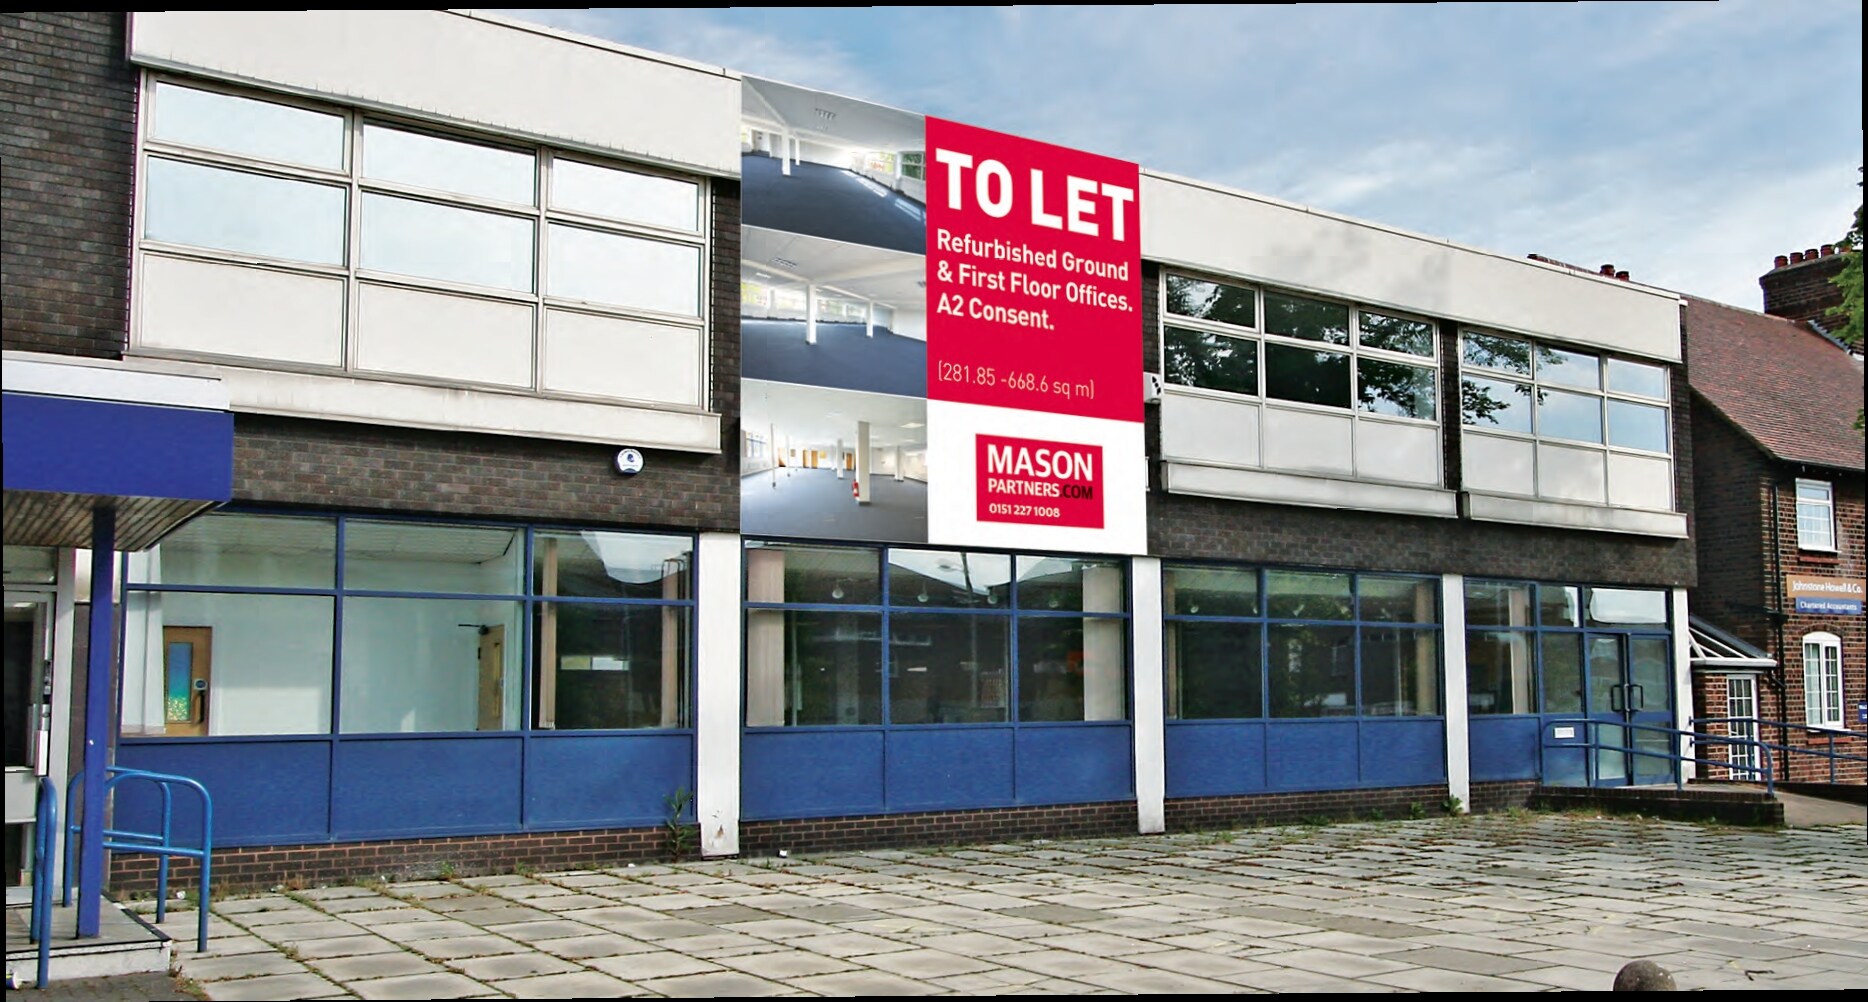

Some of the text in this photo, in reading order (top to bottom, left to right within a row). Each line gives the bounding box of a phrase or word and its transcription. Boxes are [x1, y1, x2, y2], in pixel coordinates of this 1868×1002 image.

[935, 147, 1134, 242] TO LET
[937, 228, 1129, 282] Refurbished Ground
[937, 261, 1134, 313] & First Floor Offices.
[936, 293, 1055, 331] A2 Consent.
[1000, 371, 1049, 393] -668.6
[1053, 379, 1071, 400] sq
[987, 443, 1093, 482] MASON
[988, 478, 1093, 500] PARTNERS.COM
[989, 503, 1061, 518] 0151 227 1008
[1792, 580, 1825, 592] Johnstone
[1847, 583, 1852, 593] &
[1826, 602, 1857, 610] Accountants
